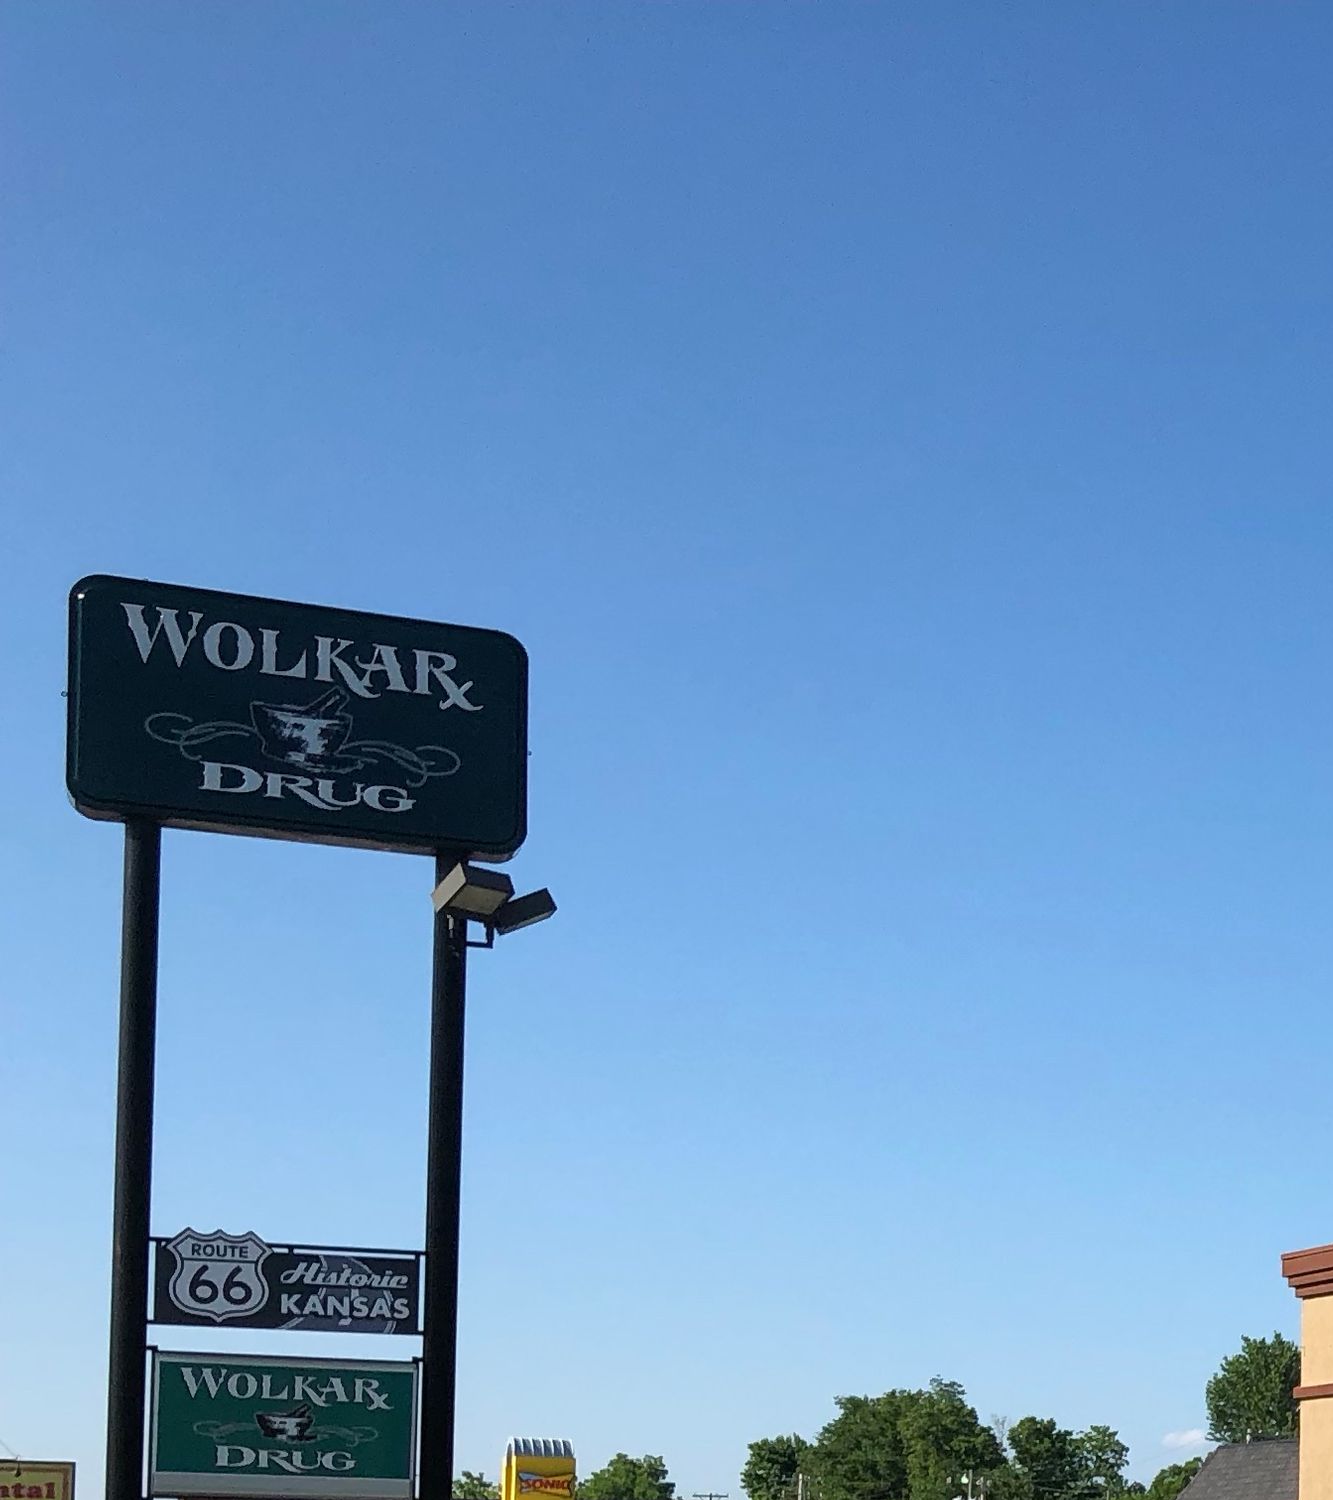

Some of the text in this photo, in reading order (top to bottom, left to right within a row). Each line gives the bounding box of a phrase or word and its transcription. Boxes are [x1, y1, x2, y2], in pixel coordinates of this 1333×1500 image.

[199, 761, 416, 813] DRUG
[191, 1243, 249, 1259] ROUTE
[188, 1264, 252, 1305] 66
[280, 1262, 409, 1289] Historic
[280, 1294, 410, 1319] KANSAS
[215, 1445, 356, 1473] DRUG
[520, 1478, 568, 1490] SONIC
